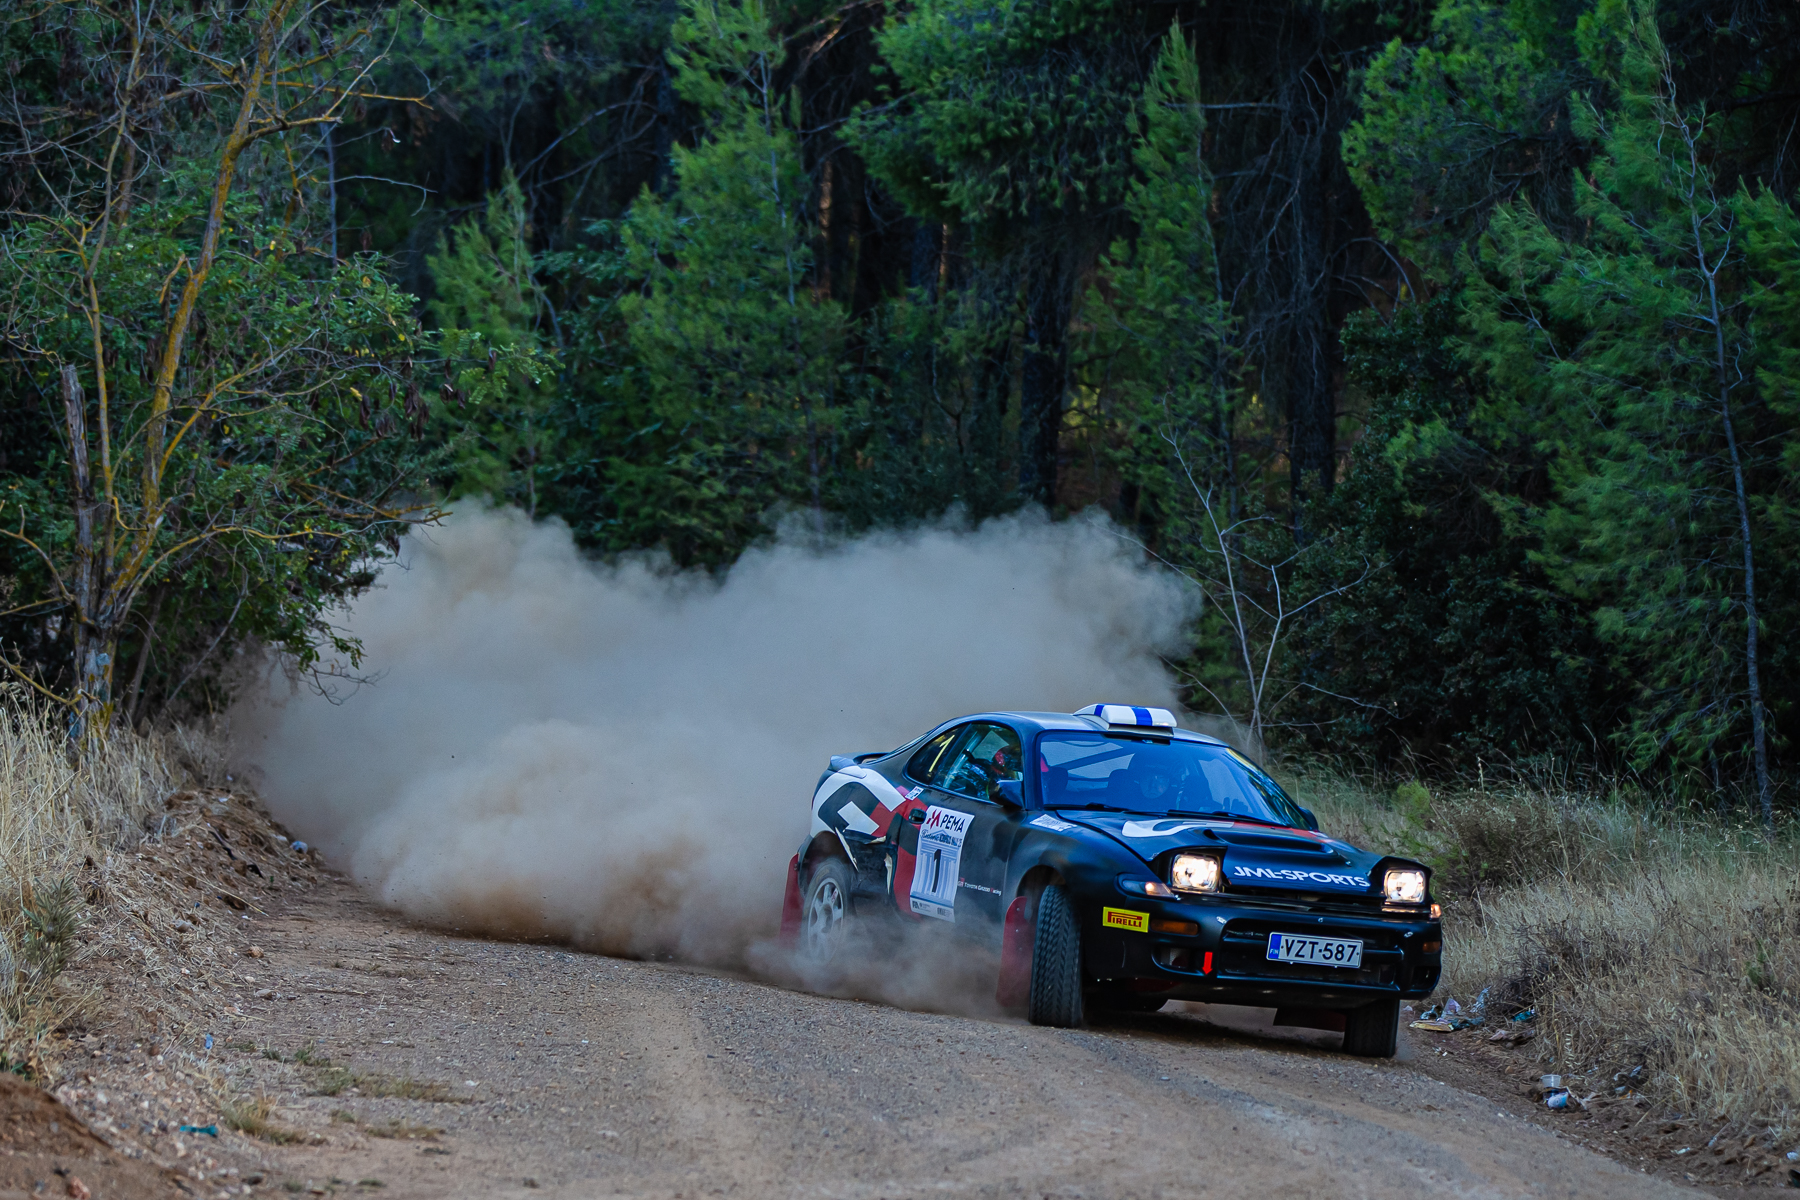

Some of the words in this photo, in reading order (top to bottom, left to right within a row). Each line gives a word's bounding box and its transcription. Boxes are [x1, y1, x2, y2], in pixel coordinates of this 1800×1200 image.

[940, 814, 966, 833] PEMA
[931, 848, 942, 893] 1
[1233, 866, 1371, 887] JML-SPORTS
[1107, 911, 1143, 927] PIRELLI
[1284, 938, 1358, 963] VZT-587
